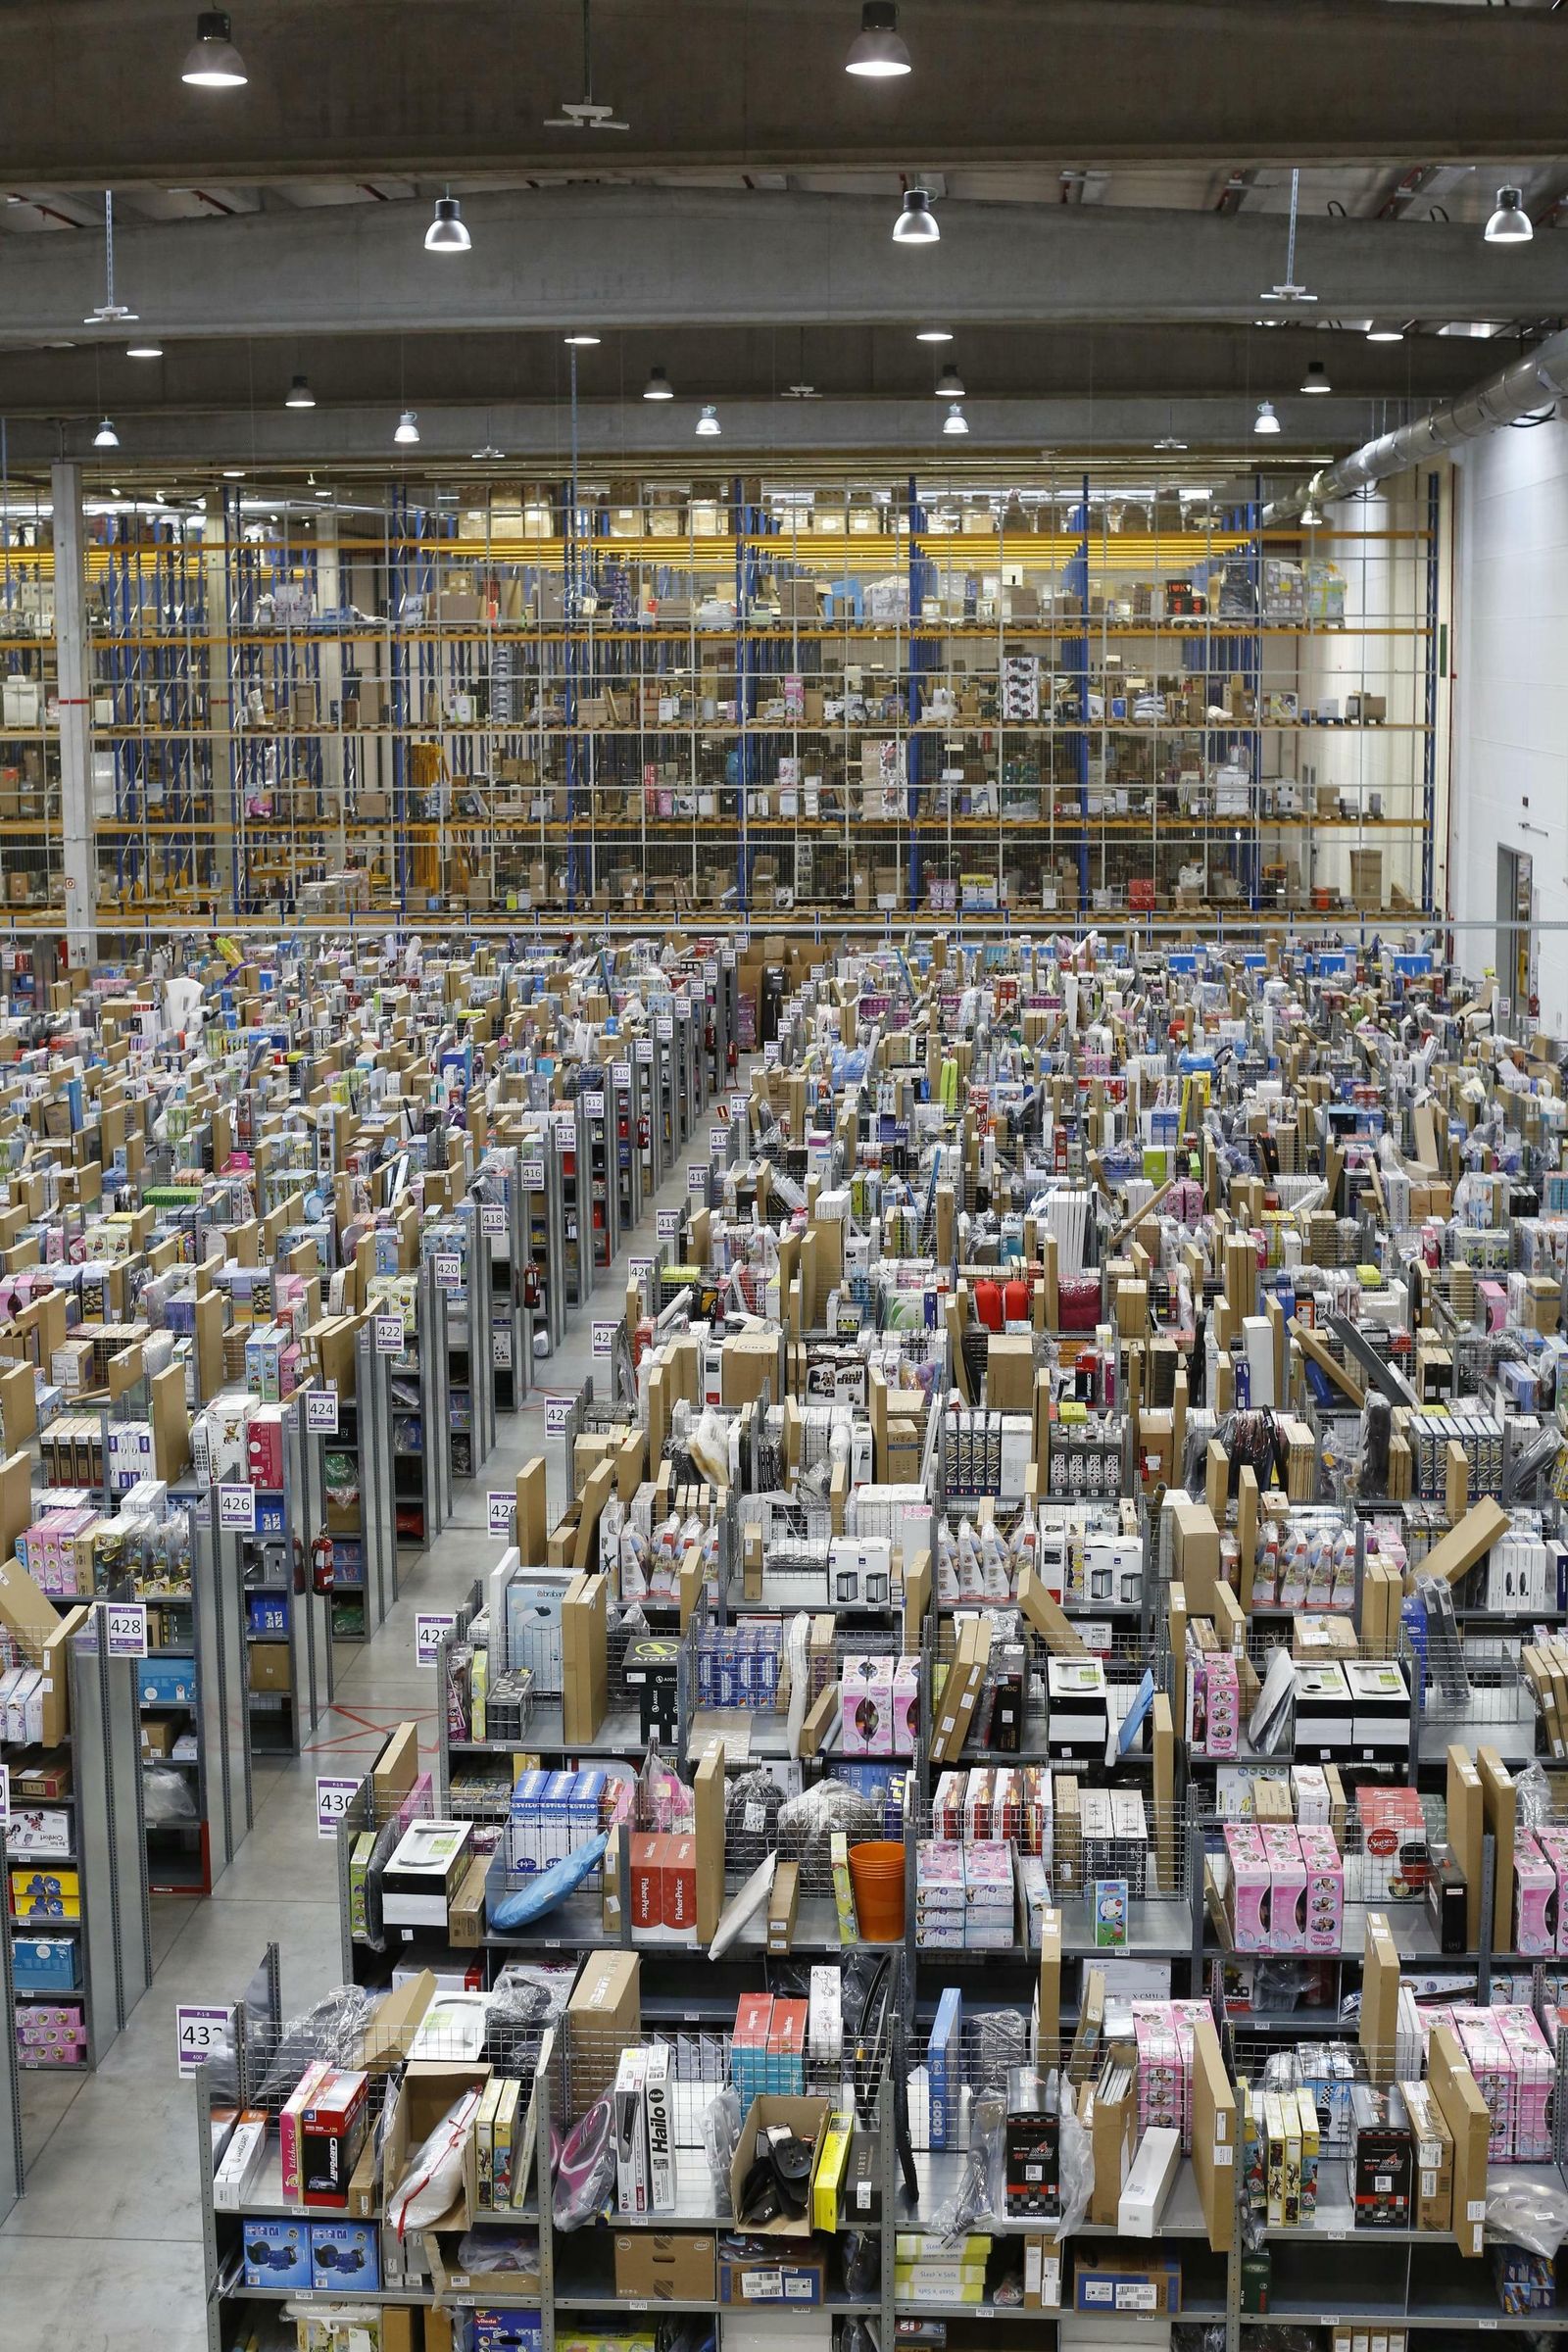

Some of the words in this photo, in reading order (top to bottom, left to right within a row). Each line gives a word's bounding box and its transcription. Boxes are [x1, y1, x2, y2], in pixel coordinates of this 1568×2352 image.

[483, 1214, 502, 1223] 418
[438, 1263, 458, 1274] 420
[378, 1326, 400, 1338] 422
[595, 1332, 614, 1343] 42
[310, 1403, 334, 1415] 424
[222, 1497, 250, 1511] 426
[111, 1619, 141, 1635] 428
[641, 1878, 650, 1919] Fisher-Price
[182, 2026, 222, 2046] 43
[288, 2128, 297, 2140] Set
[651, 2107, 668, 2154] Hailo
[288, 2141, 297, 2169] Kitchen
[621, 2192, 628, 2202] LG
